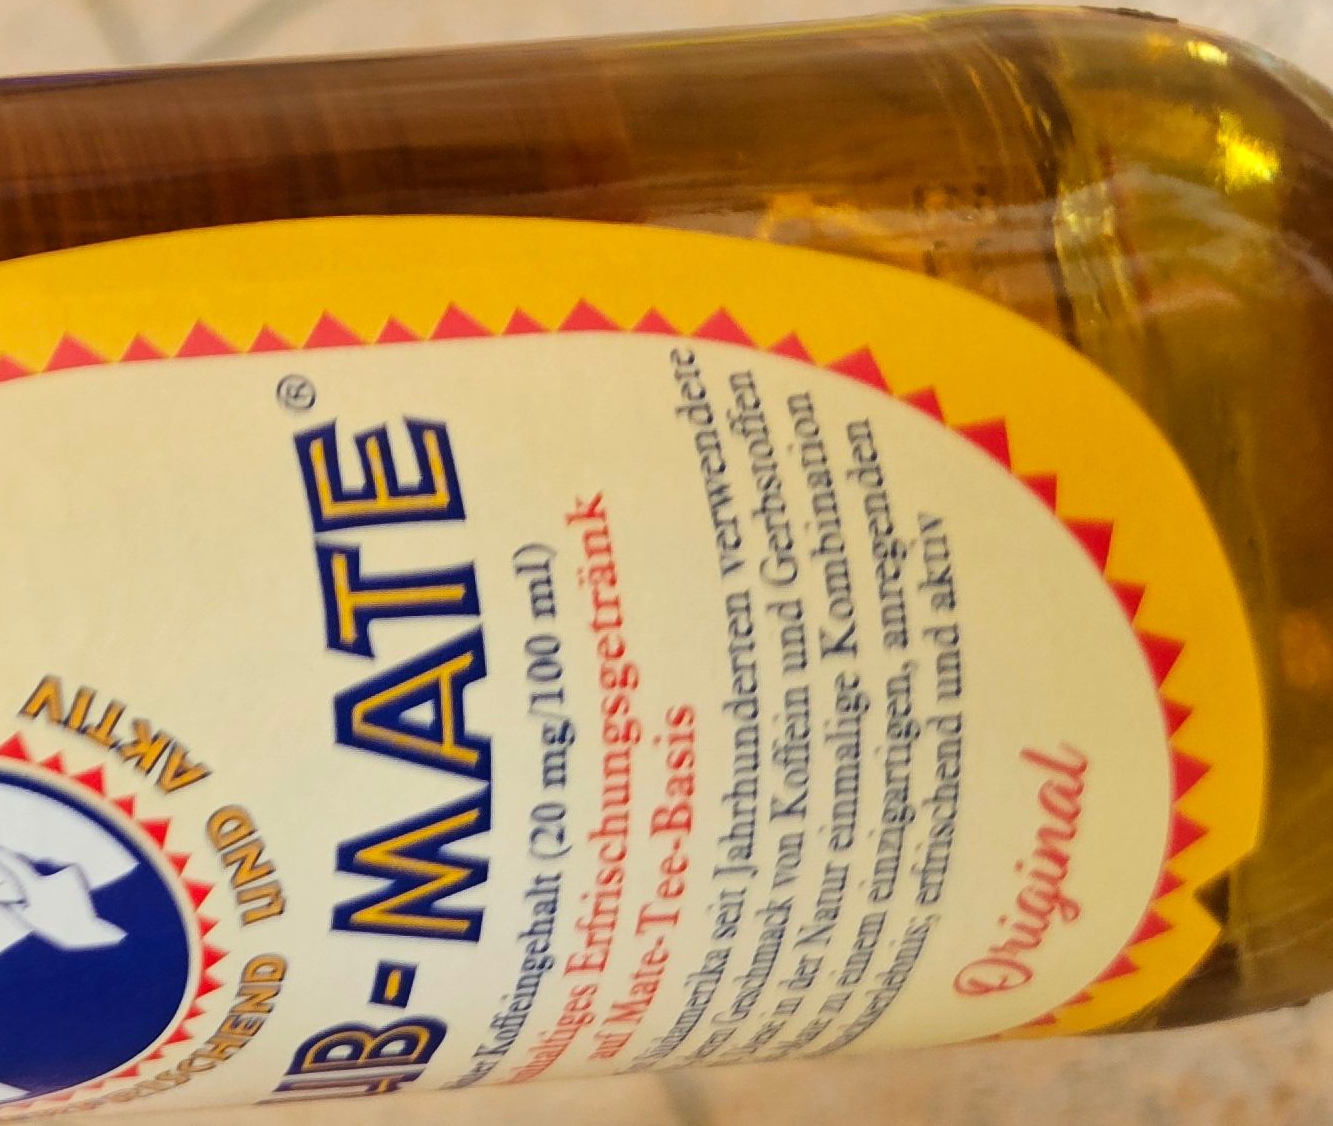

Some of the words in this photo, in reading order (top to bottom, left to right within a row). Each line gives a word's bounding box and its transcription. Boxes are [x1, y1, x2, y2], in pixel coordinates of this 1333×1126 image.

[669, 347, 745, 578] verwendete
[725, 368, 798, 587] Gerbstoffen
[785, 390, 858, 658] Kombination
[512, 541, 558, 618] ml)
[844, 417, 908, 649] anregenden
[908, 510, 956, 610] aktiv
[766, 598, 807, 675] und
[920, 623, 963, 701] und
[17, 673, 212, 794] AKTIV
[268, 414, 492, 1101] UB-MATE
[523, 633, 575, 788] mg/100
[562, 488, 642, 975] Erfrischungsgetränk
[711, 588, 759, 878] Jahrhunderten
[767, 683, 811, 822] Koffein
[816, 670, 871, 852] einmalige
[527, 801, 573, 859] (20
[858, 659, 921, 903] einzigartigen,
[908, 710, 963, 906] erfrischend
[205, 803, 286, 926] UND
[602, 703, 696, 1024] Mate-Tee-Basis
[705, 885, 748, 939] seit
[769, 829, 806, 890] von
[792, 861, 851, 949] Natur
[951, 741, 1089, 997] Original
[471, 870, 563, 1057] Koffeingehalt
[710, 895, 794, 1024] Geschmack
[759, 994, 804, 1016] in
[777, 953, 824, 989] der
[815, 989, 854, 1014] zu
[828, 909, 888, 986] einem
[587, 1027, 634, 1059] auf
